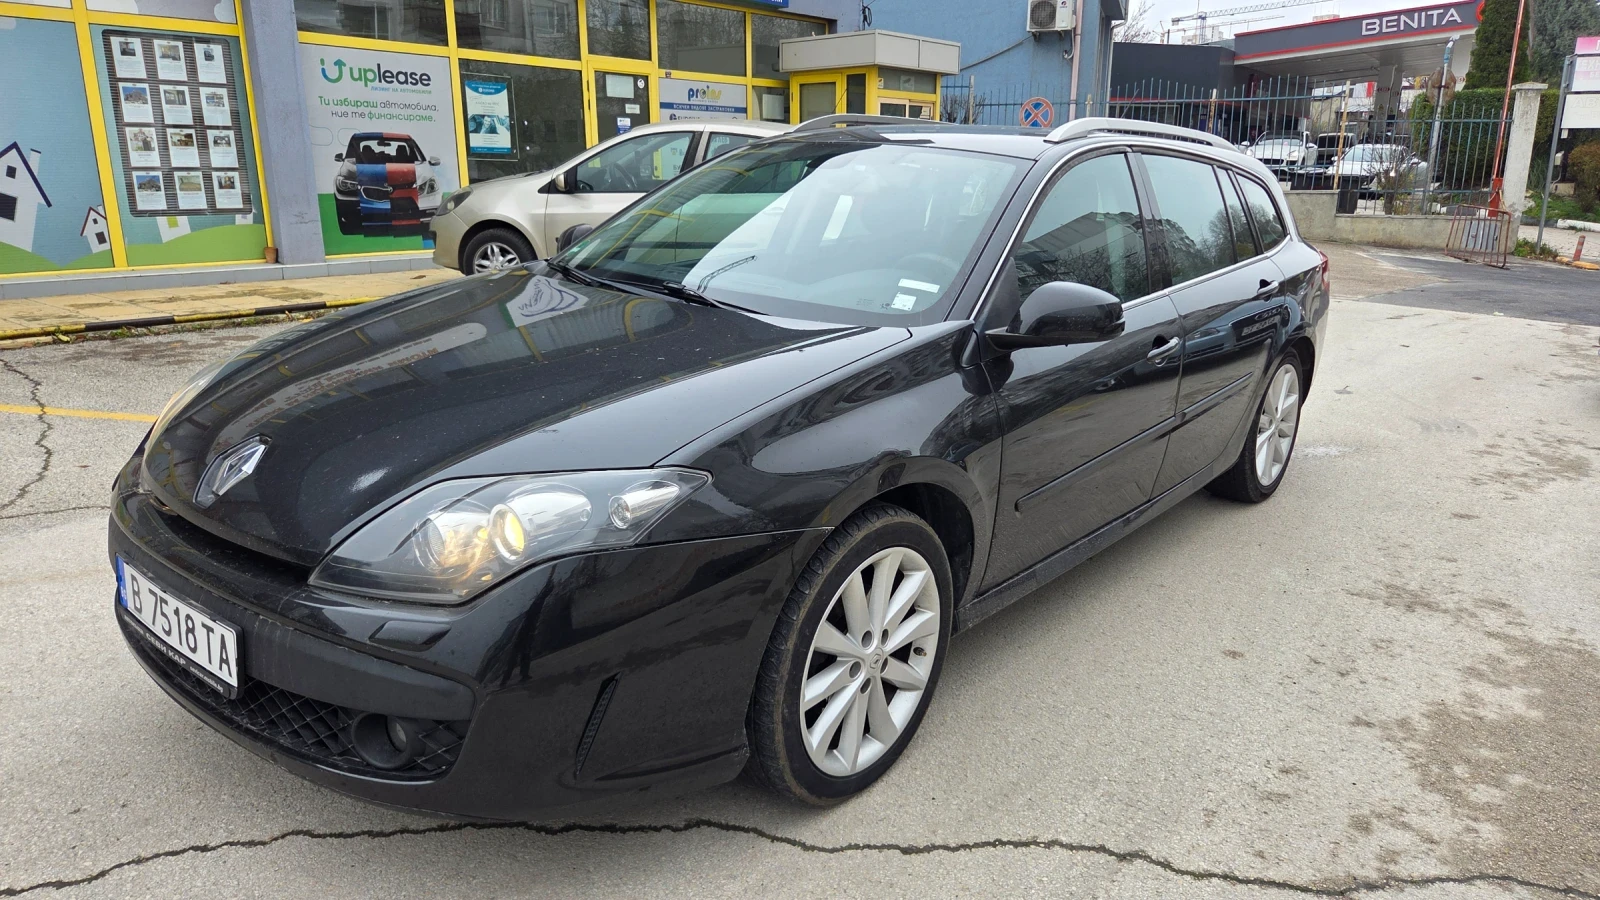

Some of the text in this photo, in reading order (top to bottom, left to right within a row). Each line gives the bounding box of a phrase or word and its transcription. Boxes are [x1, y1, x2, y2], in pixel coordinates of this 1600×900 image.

[1361, 8, 1462, 35] BENITA
[349, 63, 431, 87] uplease
[318, 96, 439, 112] Ти избираш автомобила,
[331, 110, 349, 118] ние
[367, 111, 436, 122] финансираме.
[130, 573, 233, 679] B 7518 TA
